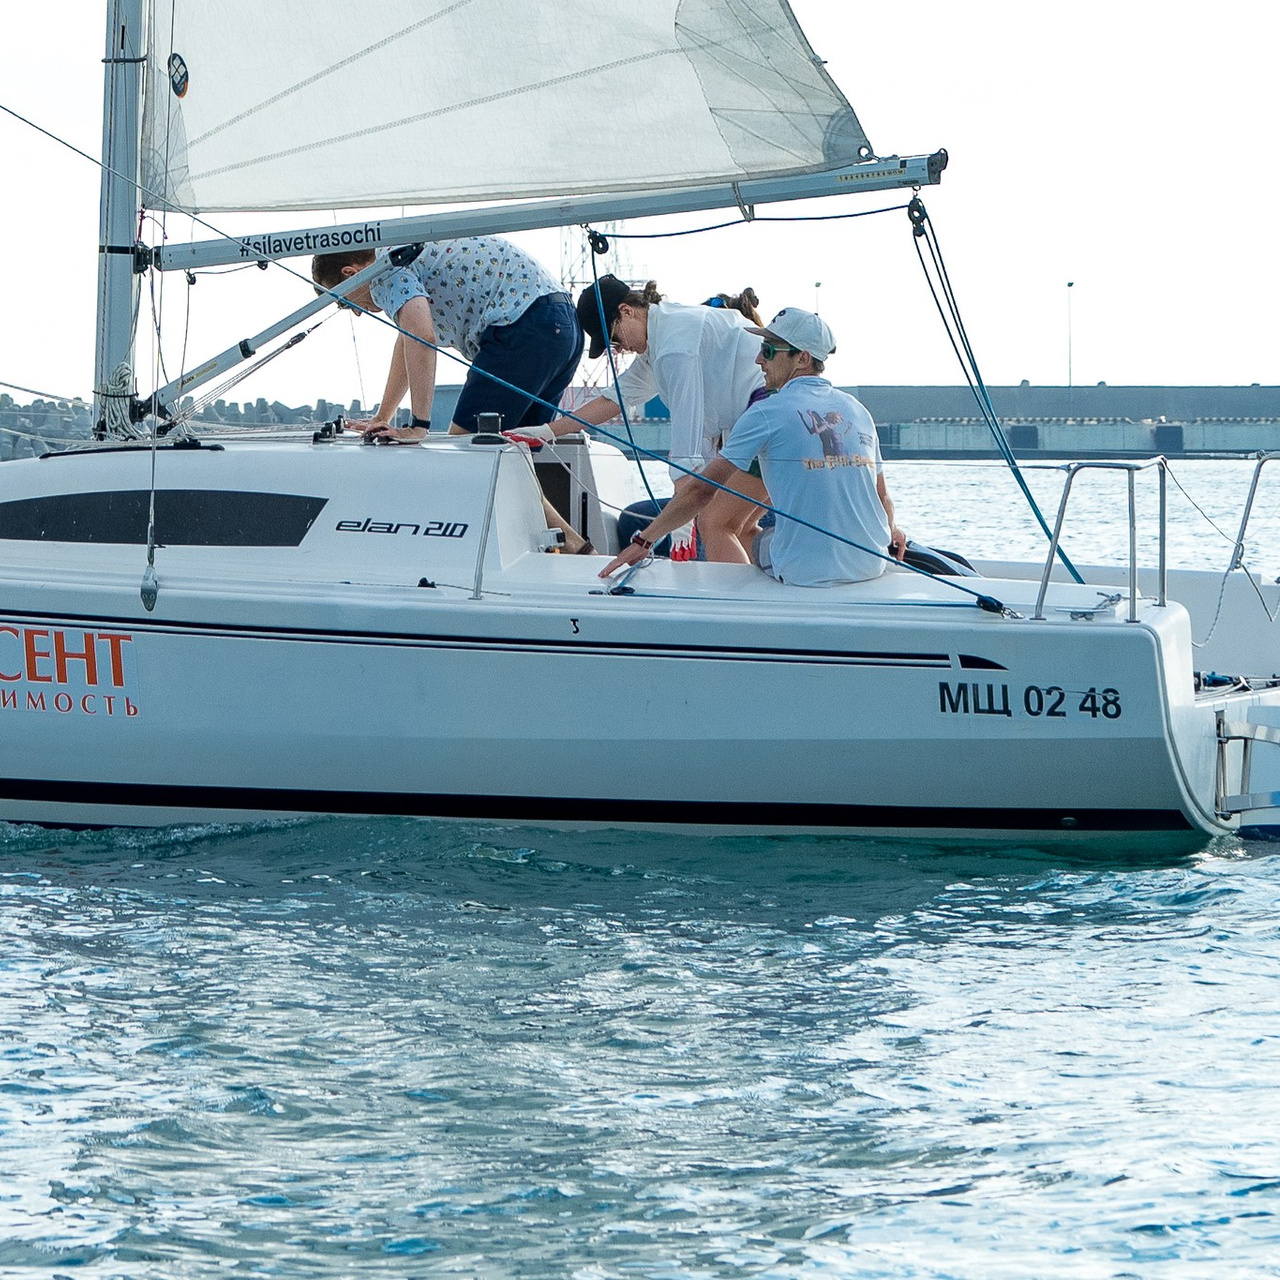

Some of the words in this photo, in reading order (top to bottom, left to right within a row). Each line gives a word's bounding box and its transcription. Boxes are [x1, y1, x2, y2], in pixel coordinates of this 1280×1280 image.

[238, 222, 382, 258] #silavetrasochi
[335, 517, 421, 536] elan
[422, 520, 469, 538] 210
[938, 681, 1013, 718] МЩ
[1023, 685, 1067, 718] 02
[1078, 687, 1122, 719] 48
